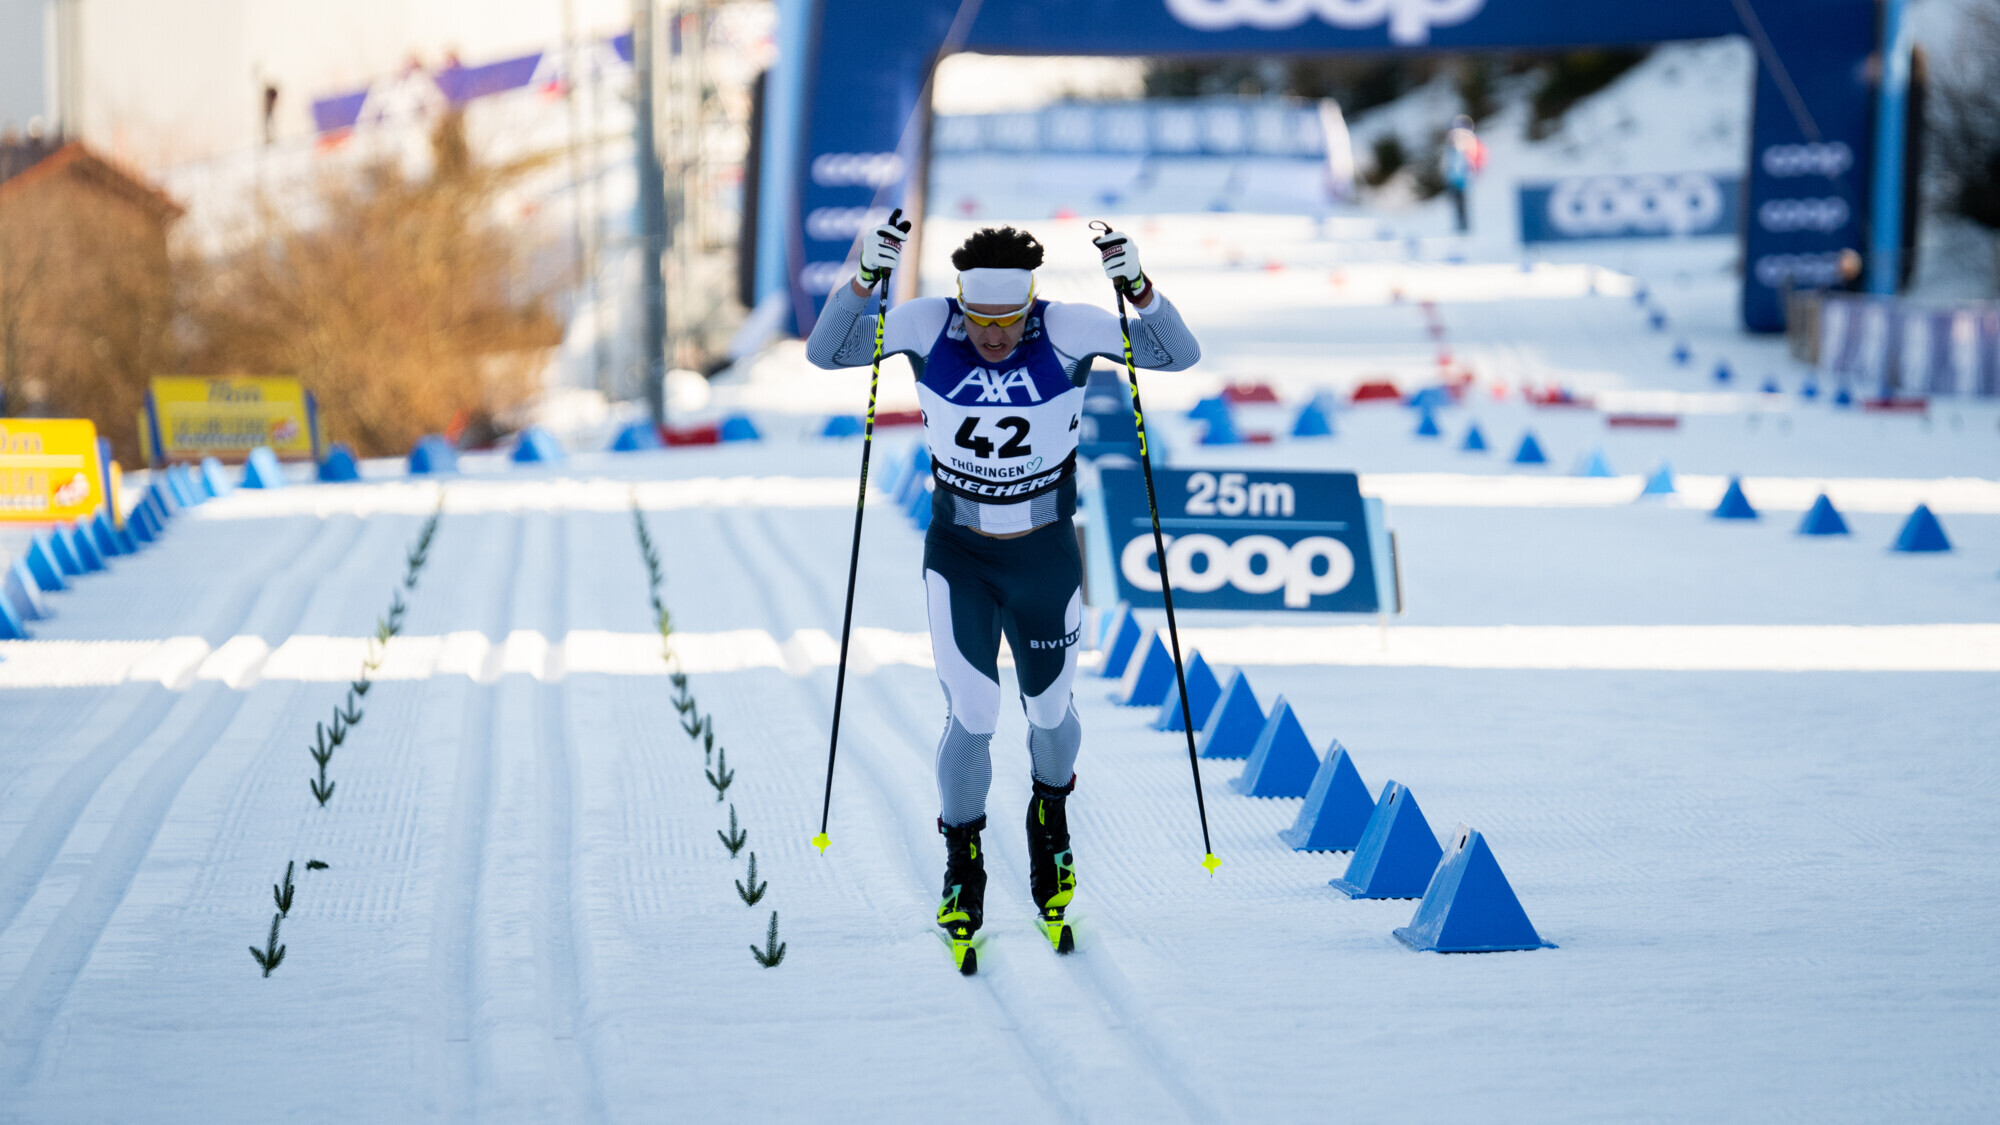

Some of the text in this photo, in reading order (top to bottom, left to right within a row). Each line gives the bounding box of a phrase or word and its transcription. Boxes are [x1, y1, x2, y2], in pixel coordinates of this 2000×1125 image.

[1547, 171, 1724, 236] coop
[946, 366, 1042, 403] AXA
[955, 416, 1031, 458] 42
[936, 467, 1062, 496] SKECHERS
[950, 457, 1025, 478] THÜRINGEN
[1185, 472, 1295, 517] 25m
[1121, 533, 1355, 608] coop
